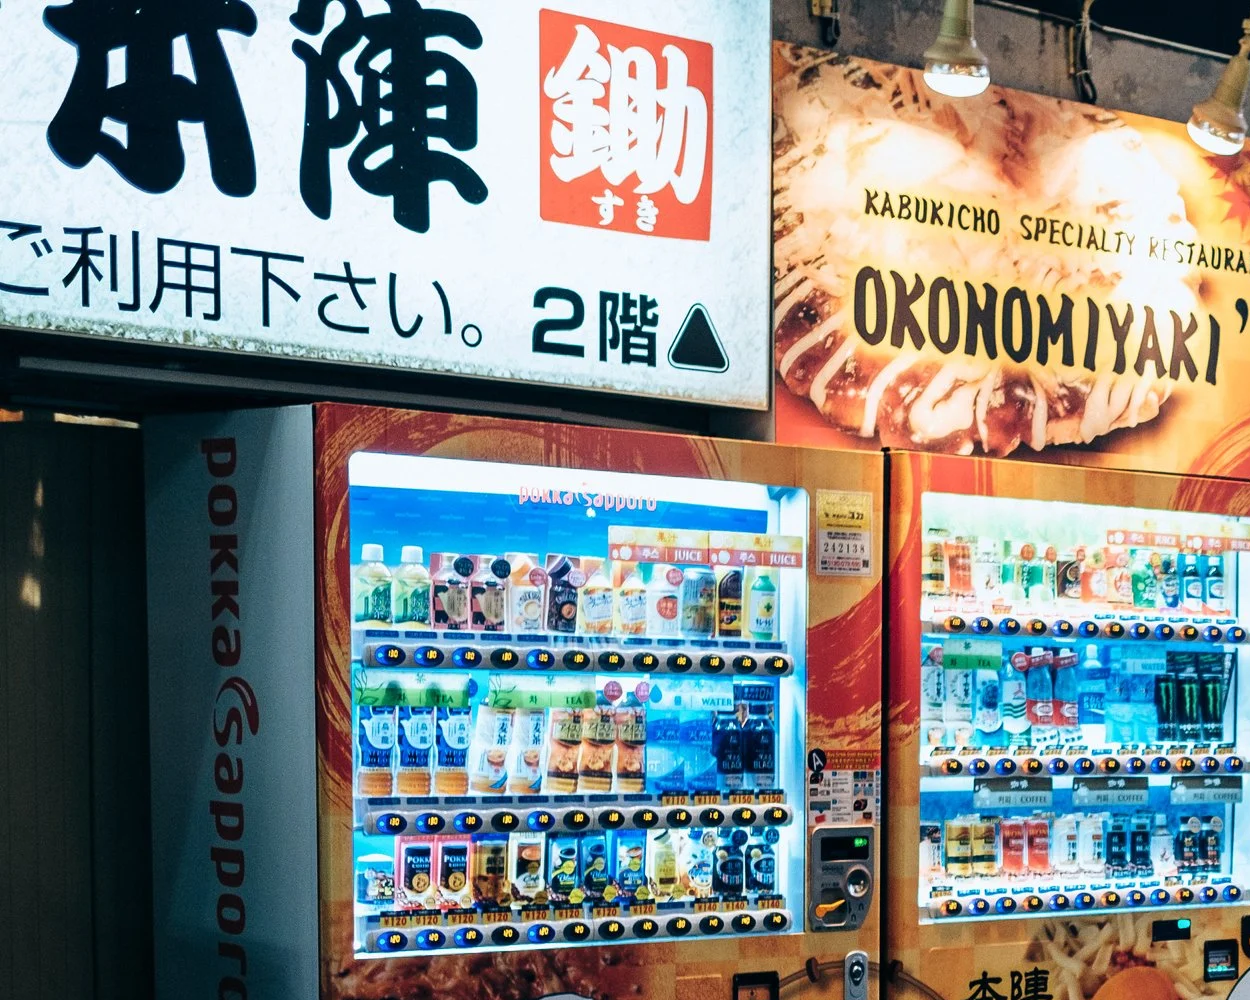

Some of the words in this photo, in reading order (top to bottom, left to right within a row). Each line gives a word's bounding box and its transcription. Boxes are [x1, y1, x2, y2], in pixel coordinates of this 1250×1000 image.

[592, 190, 660, 233] すき
[864, 188, 1001, 236] KABUKICHO
[1020, 214, 1138, 256] SPECIALTY
[532, 286, 658, 367] 2階
[853, 266, 1221, 386] OKONOMIYAKI
[199, 436, 240, 667] pokka
[673, 549, 702, 562] JUICE
[769, 554, 797, 566] JUICE
[977, 658, 991, 667] TEA
[1141, 662, 1166, 671] WATER
[565, 695, 583, 705] TEA
[701, 697, 732, 706] WATER
[1020, 795, 1048, 804] COFFEE
[1117, 794, 1144, 802] COFFEE
[1213, 792, 1239, 801] COFFEE
